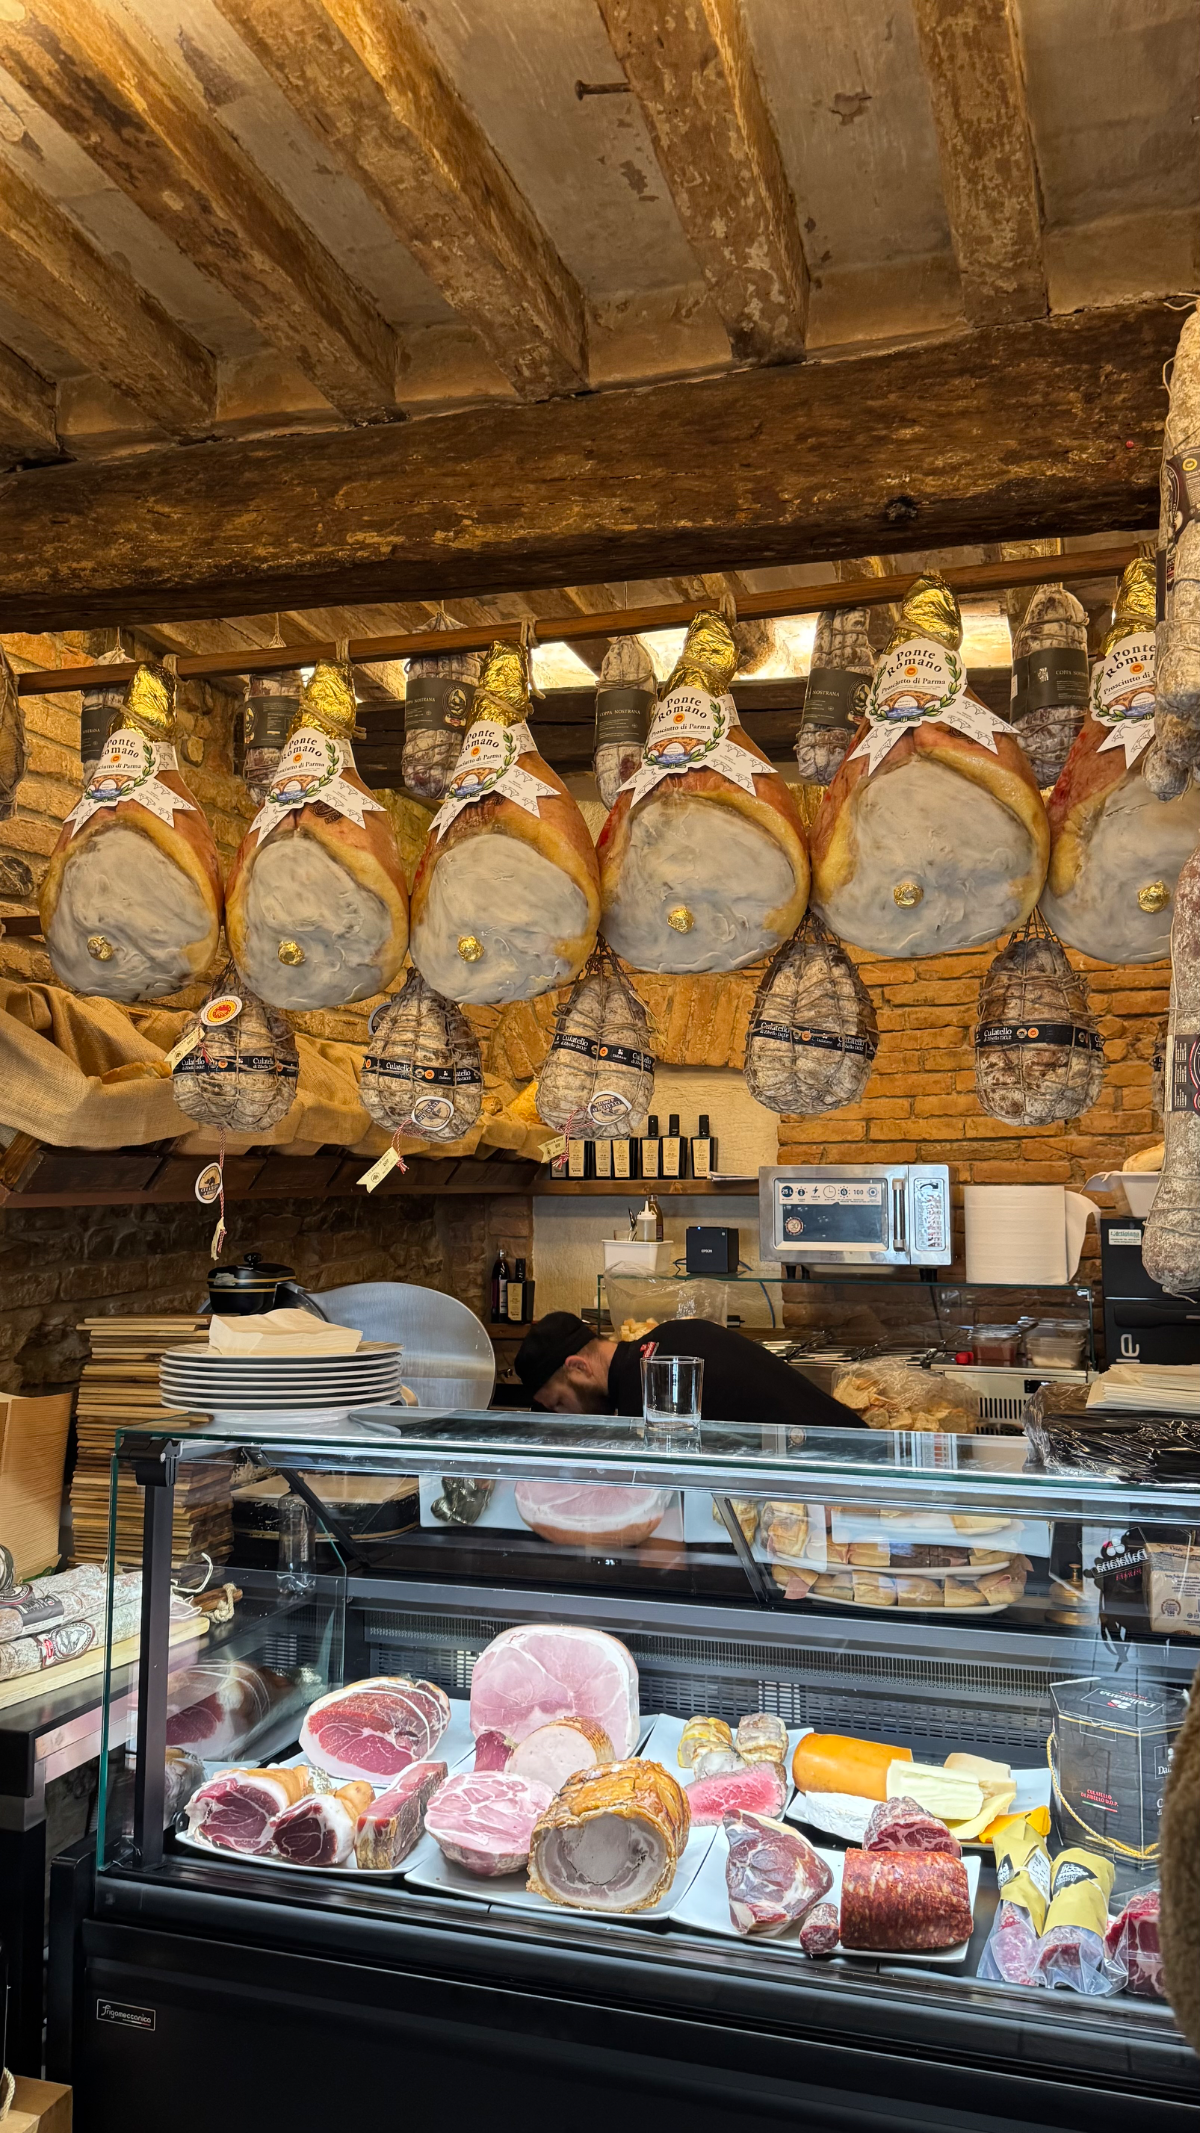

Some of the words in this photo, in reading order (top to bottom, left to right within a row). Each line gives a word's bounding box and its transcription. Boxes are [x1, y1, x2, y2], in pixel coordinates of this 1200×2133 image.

[896, 649, 936, 662] Ponte
[1112, 644, 1156, 663] Ponte
[886, 658, 942, 678] Romano
[1105, 654, 1155, 679] Roman
[1103, 676, 1140, 694] Prosciutto
[1142, 671, 1151, 679] di
[666, 696, 702, 710] Ponte
[657, 706, 708, 723] Romano
[288, 737, 318, 750] Ponte
[466, 730, 495, 743] Ponte
[984, 1028, 1012, 1037] Culatello
